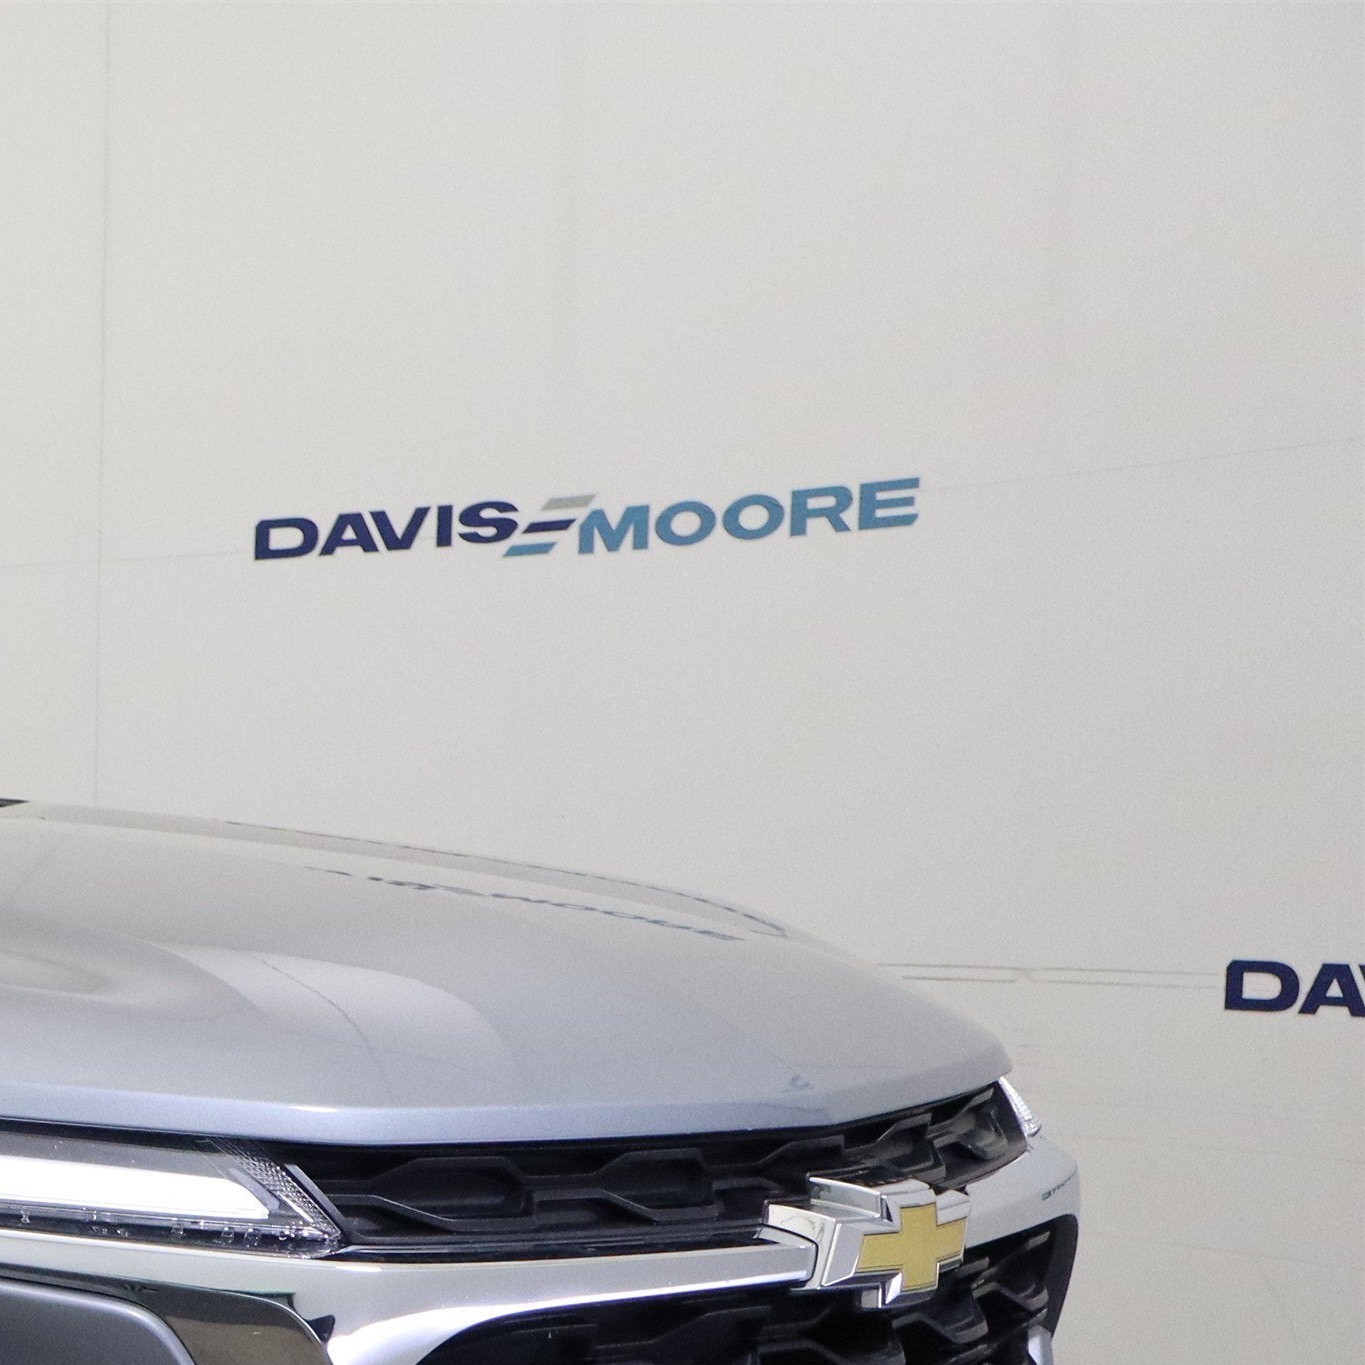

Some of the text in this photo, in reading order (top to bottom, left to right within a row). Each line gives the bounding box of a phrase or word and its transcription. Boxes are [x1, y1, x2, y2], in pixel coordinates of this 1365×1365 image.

[253, 475, 922, 561] DAVIS MOORE
[1224, 959, 1365, 1017] DA
